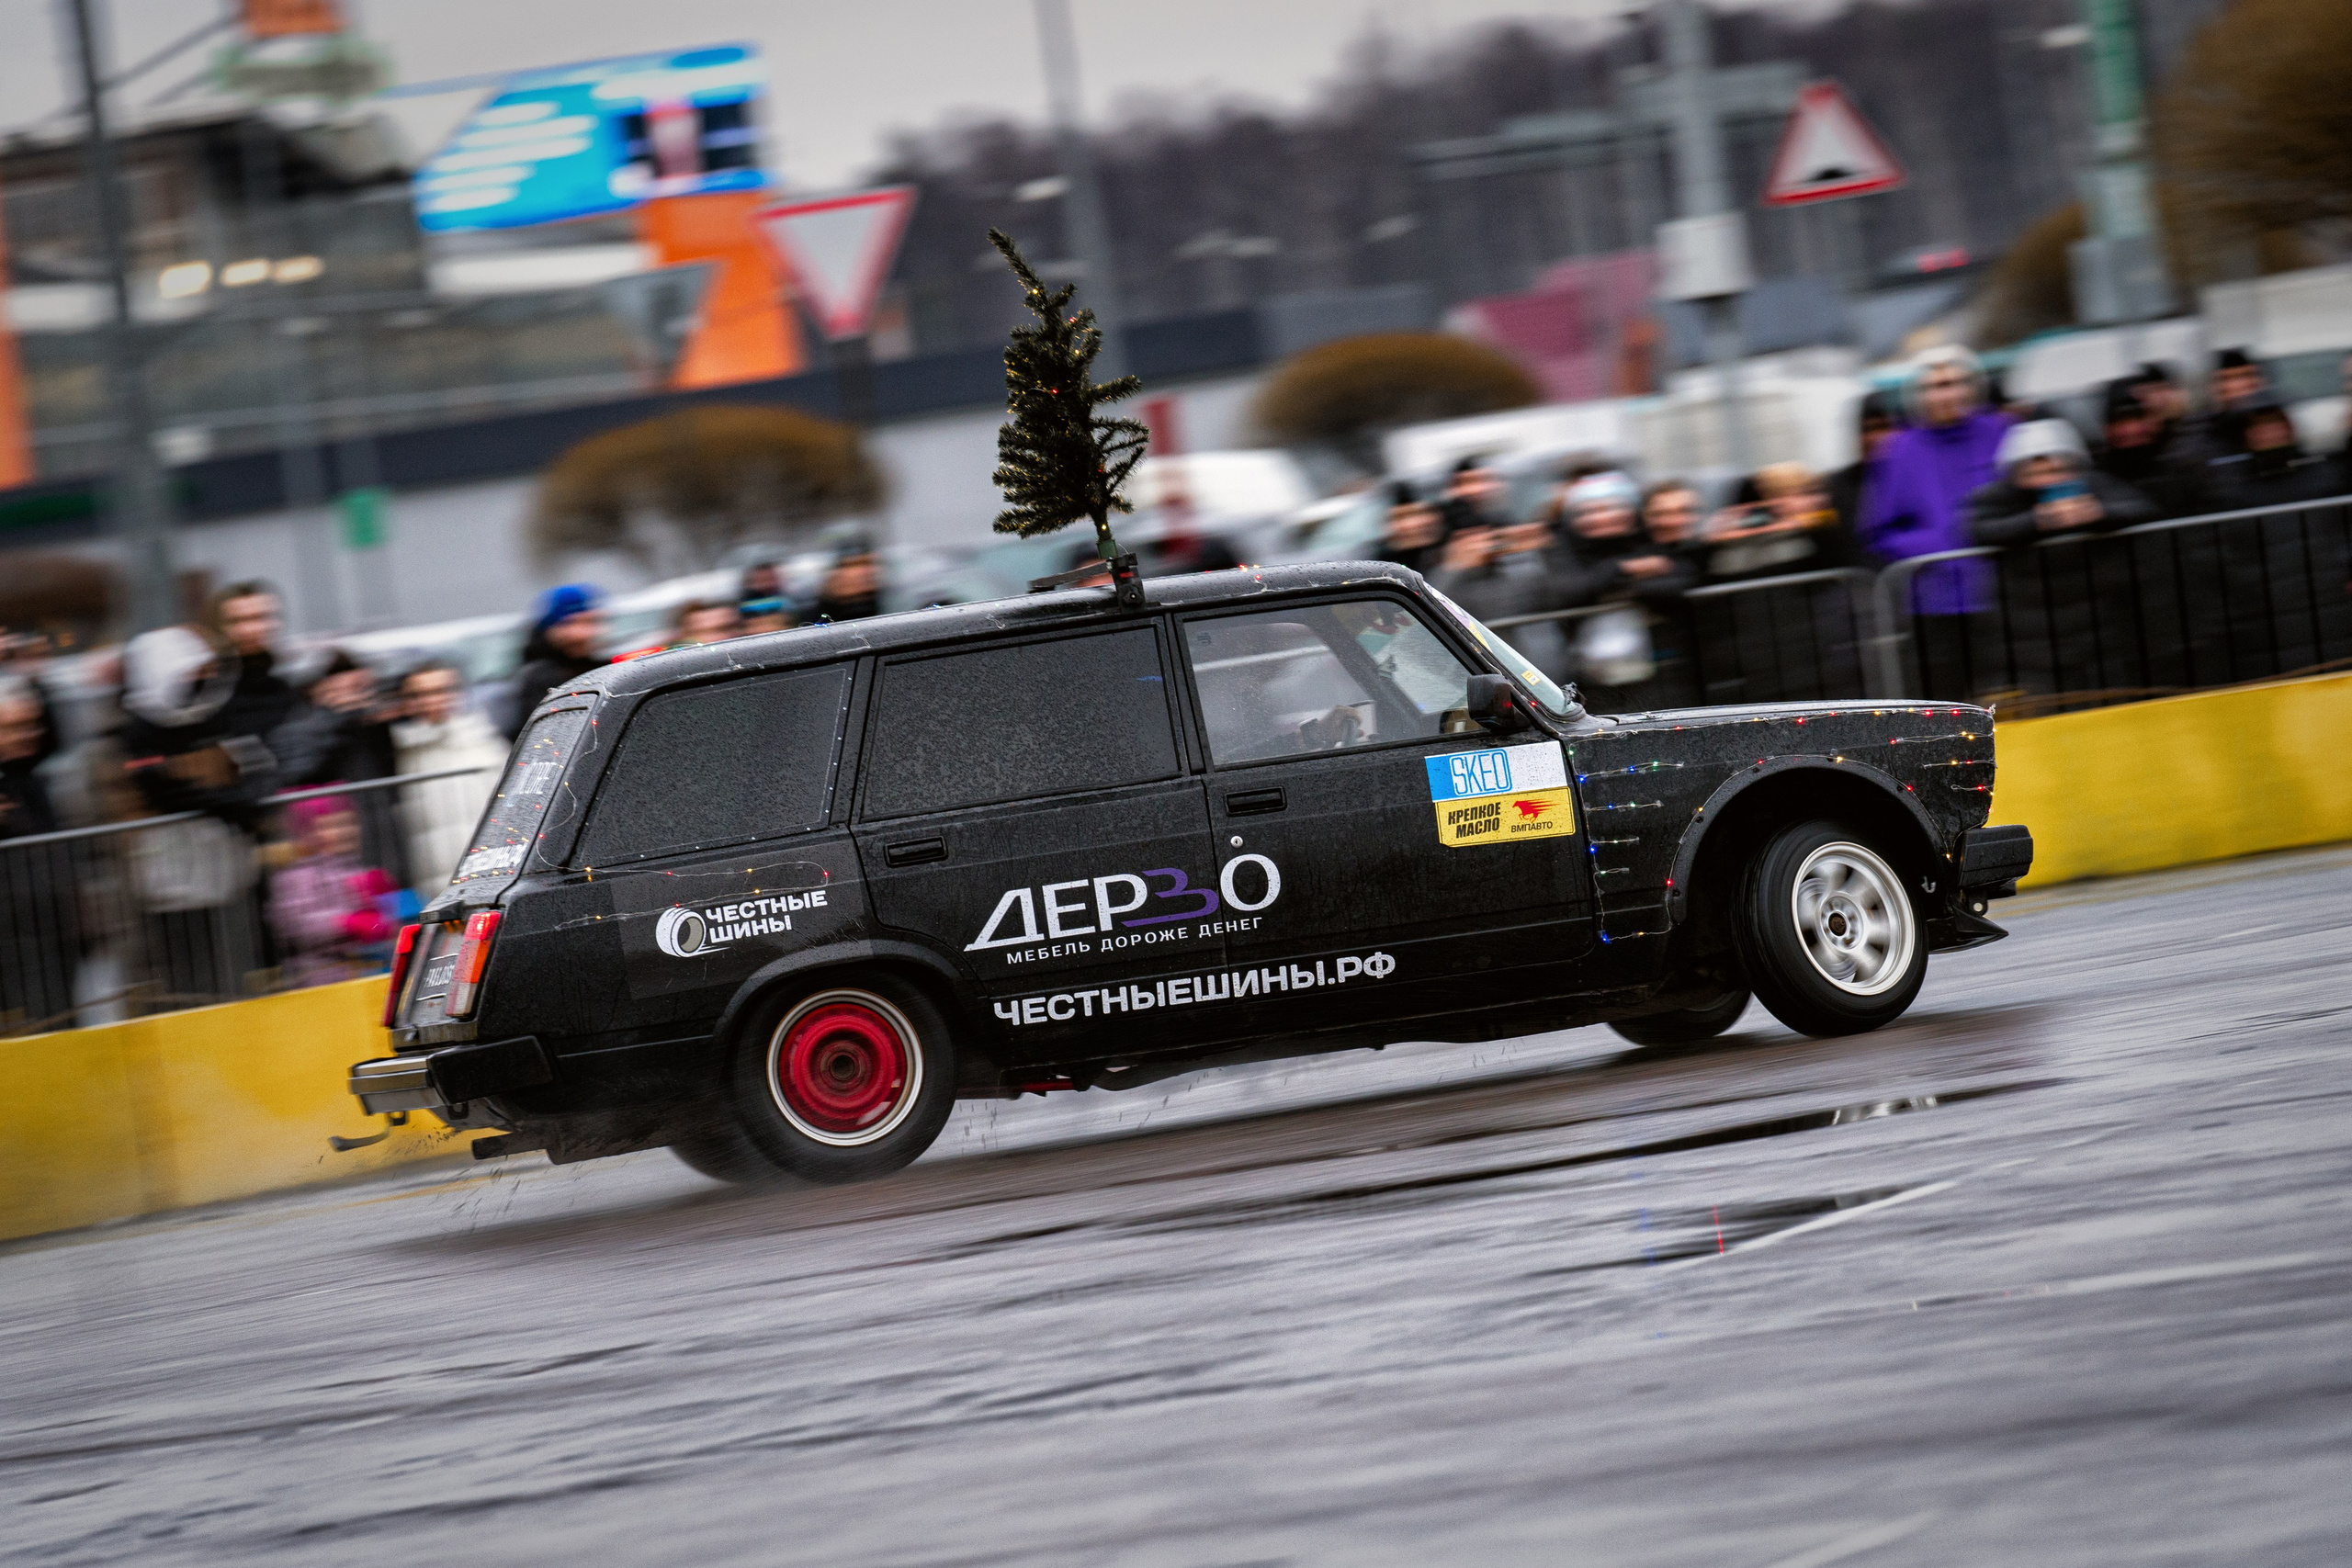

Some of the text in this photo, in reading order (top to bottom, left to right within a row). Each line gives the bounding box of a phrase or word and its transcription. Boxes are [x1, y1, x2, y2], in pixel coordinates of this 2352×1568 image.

[1450, 751, 1510, 795] SKEO
[1448, 801, 1501, 826] КРЕПКОЕ
[1455, 817, 1500, 839] МАСЛО
[1510, 821, 1554, 833] ВМПАВТО
[705, 888, 829, 923] ЧЕСТНЫЕ
[963, 853, 1282, 953] ДЕРЗО
[708, 915, 792, 945] ШИНЫ
[1006, 917, 1263, 964] МЕБЕЛЬ ДОРОЖЕ ДЕНЕГ
[993, 951, 1396, 1026] ЧЕСТНЫЕШИНЫ.РФ
